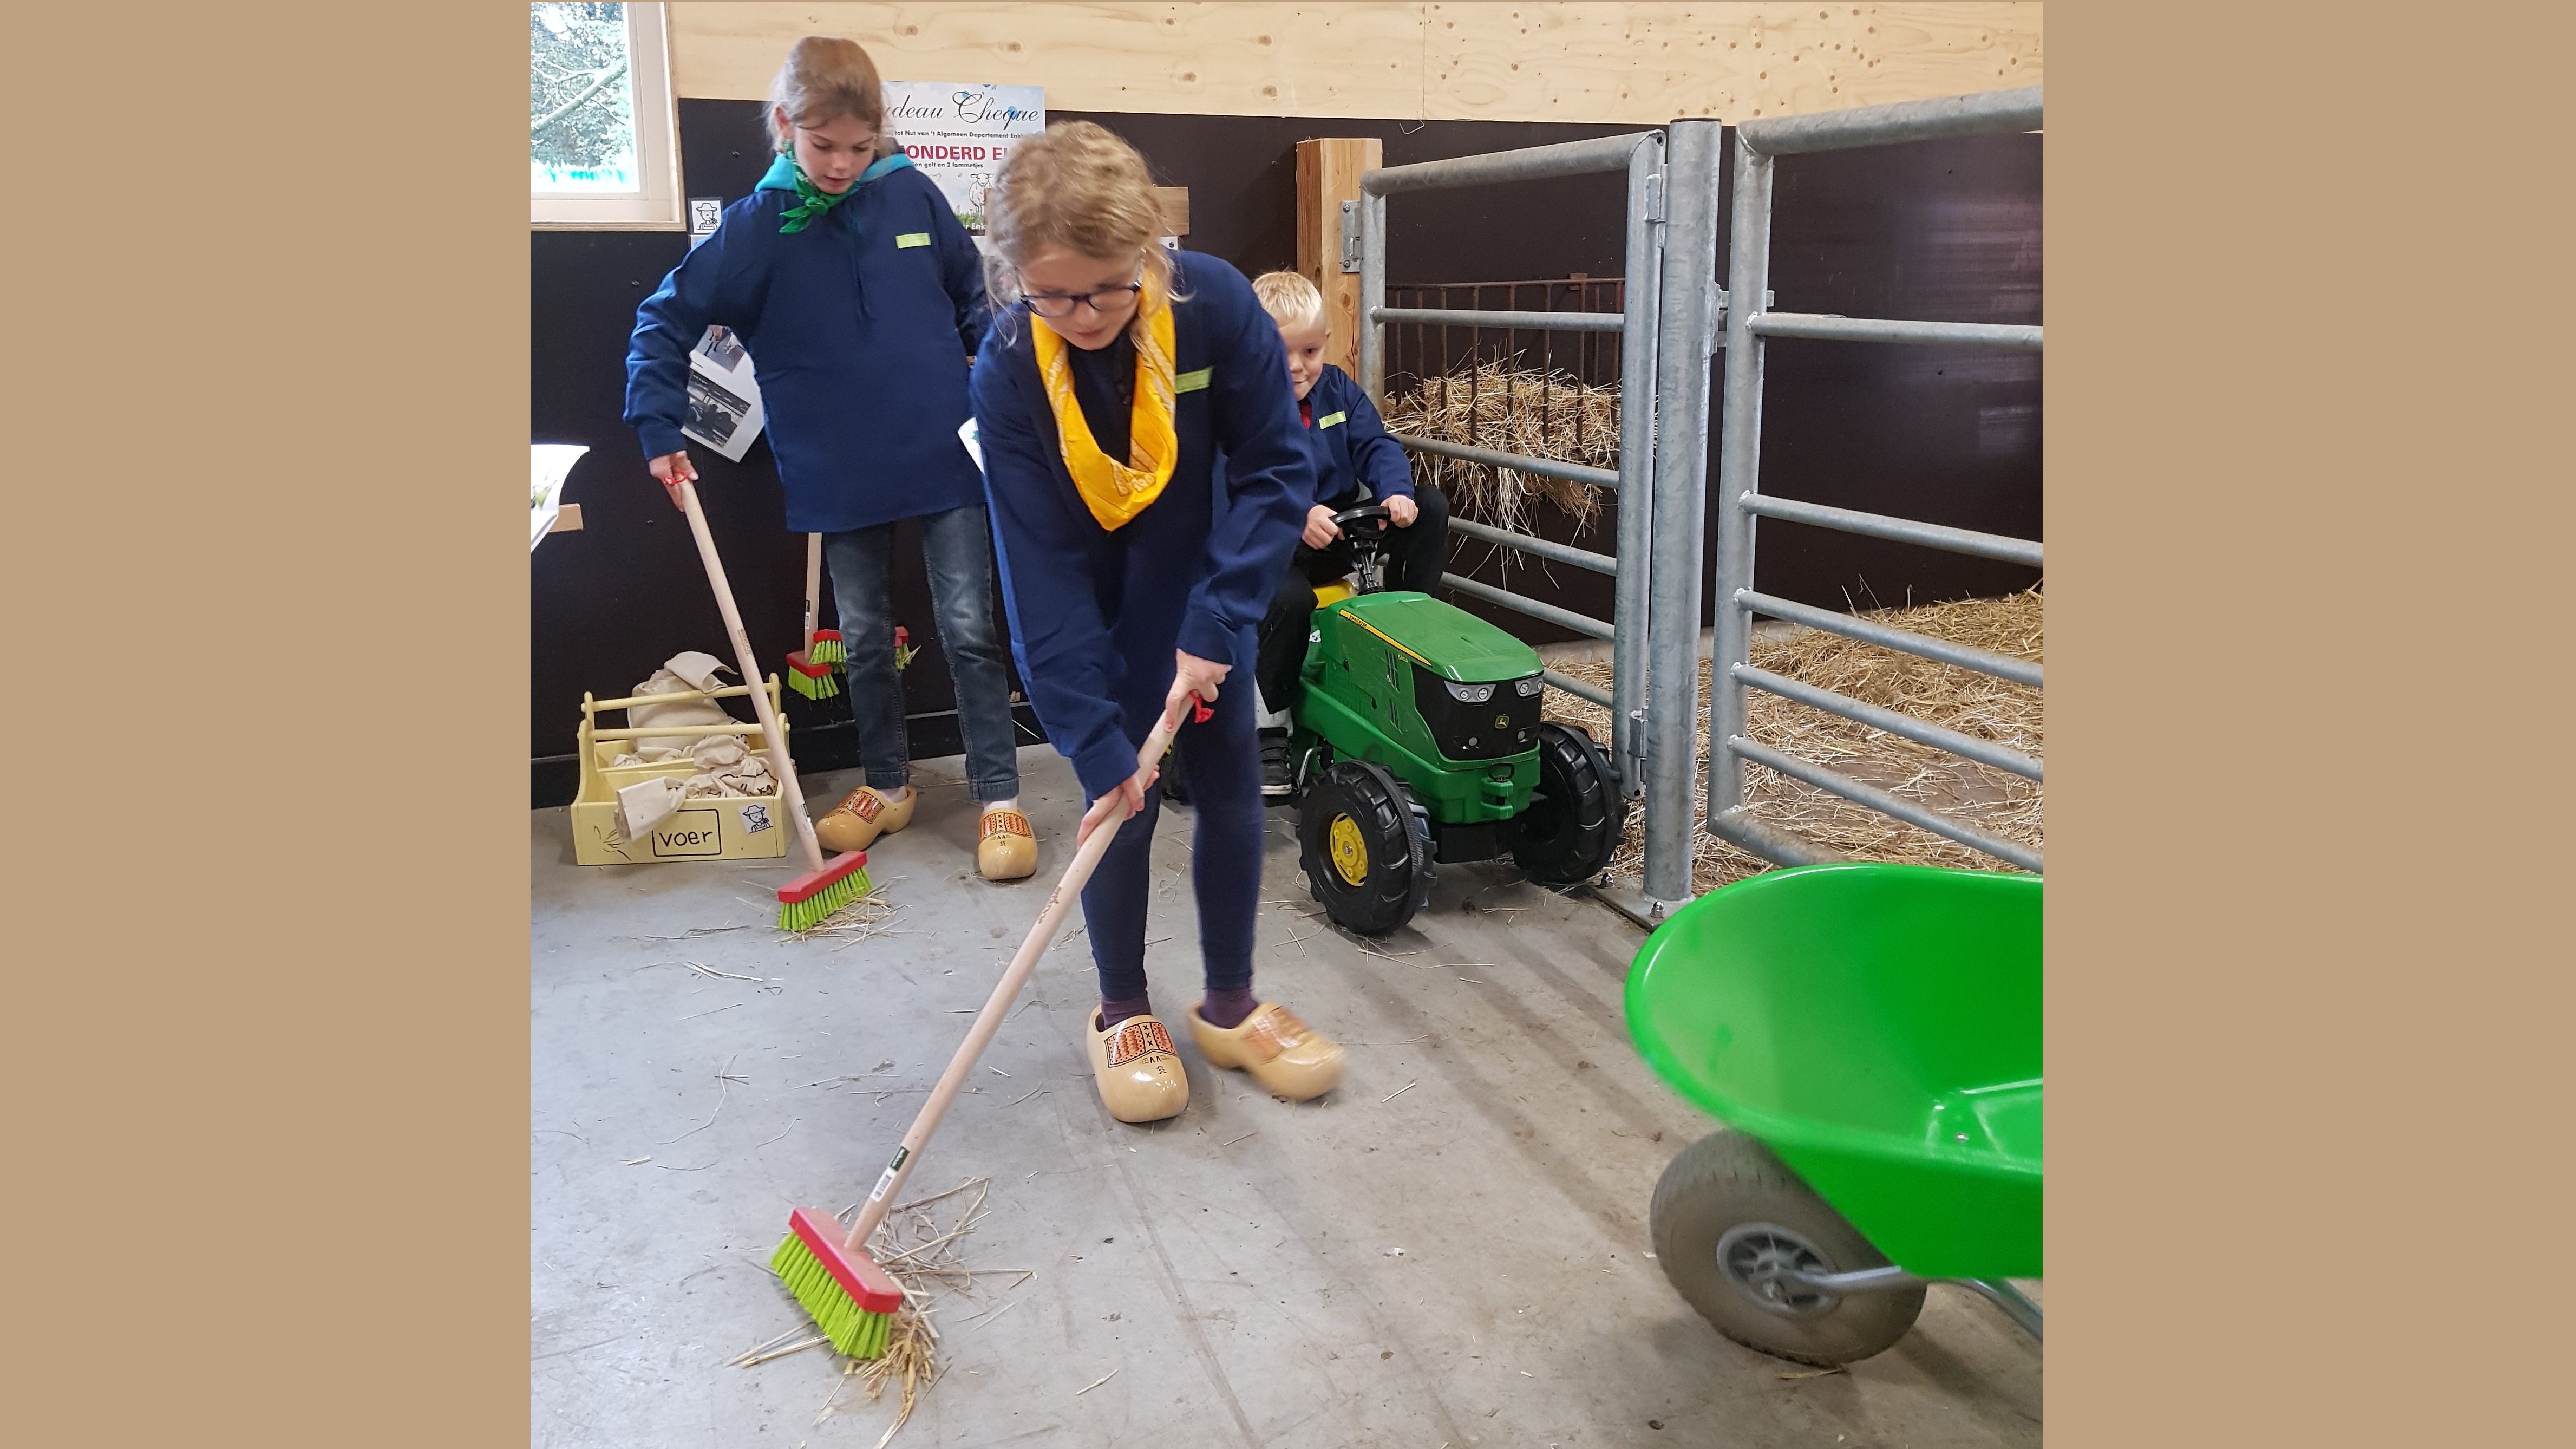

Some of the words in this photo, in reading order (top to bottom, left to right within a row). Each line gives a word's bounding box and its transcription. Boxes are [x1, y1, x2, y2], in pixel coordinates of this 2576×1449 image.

[952, 92, 1039, 130] Cheque
[900, 145, 986, 160] ONDERD
[658, 831, 714, 847] voer
